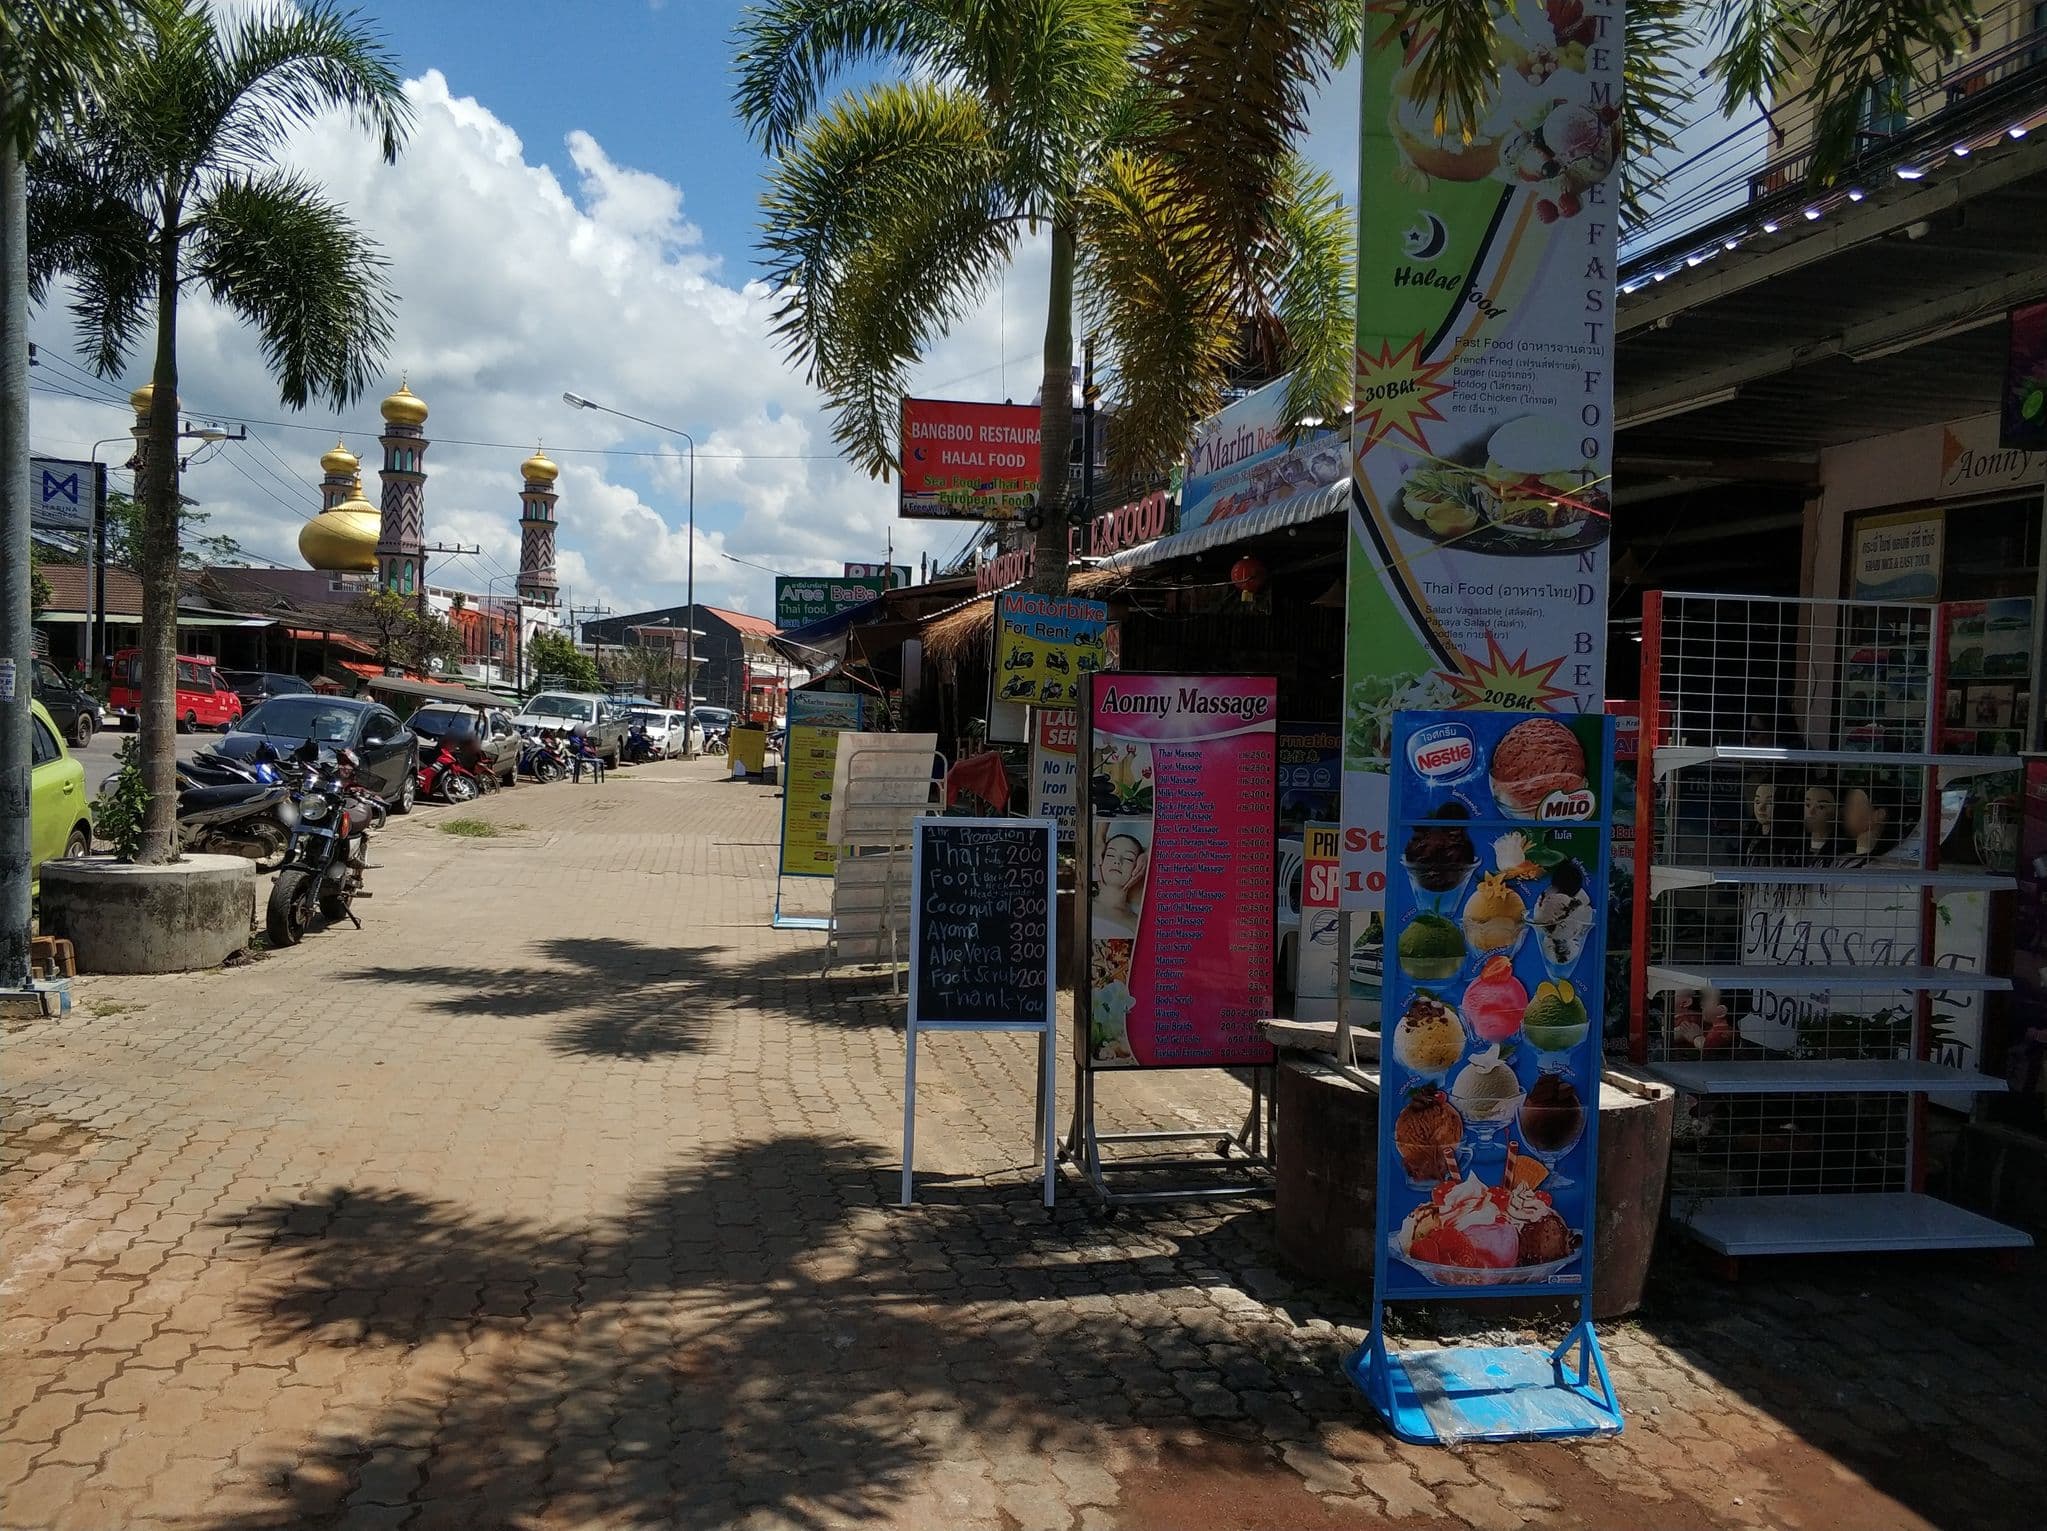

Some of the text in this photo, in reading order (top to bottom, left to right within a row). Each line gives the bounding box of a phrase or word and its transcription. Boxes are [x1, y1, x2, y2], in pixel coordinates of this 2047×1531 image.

[1394, 266, 1461, 291] Halal
[1584, 223, 1608, 344] FAST
[1455, 337, 1480, 348] Fast
[1485, 338, 1513, 350] Food
[1454, 355, 1512, 367] French Fried
[1453, 367, 1485, 378] Burger
[1453, 380, 1487, 391] Hotdog
[1453, 392, 1476, 401] Fried
[1480, 393, 1517, 403] Chicken
[912, 422, 1041, 445] BANGBOO RESTAURA
[1205, 425, 1254, 475] Marlin
[942, 450, 1026, 468] HALAL FOOD
[1949, 449, 2032, 486] Aonny
[1002, 493, 1031, 506] Food
[1090, 490, 1166, 557] EAFOOD
[780, 585, 877, 602] Aree BaBa
[1423, 582, 1453, 594] Thai
[1458, 583, 1493, 596] Food
[779, 604, 800, 614] Thai
[1004, 594, 1105, 621] Motorbike
[1425, 605, 1453, 615] Salad
[1004, 620, 1073, 639] For Rent
[1463, 617, 1491, 627] Salad
[1572, 632, 1596, 713] BEV
[1102, 686, 1268, 720] Aonny Massage
[1046, 711, 1077, 726] LAU
[1048, 729, 1077, 745] SER
[1175, 749, 1202, 759] Massage
[1043, 761, 1077, 775] No Ir
[1175, 763, 1202, 772] Massage
[1042, 781, 1067, 794] Iron
[1041, 803, 1076, 820] Expre
[1545, 801, 1590, 818] MILO
[928, 840, 980, 868] Thai
[1006, 845, 1042, 865] 200
[930, 867, 980, 888] Foot
[1006, 868, 1045, 888] 250
[1310, 865, 1339, 901] SP
[926, 893, 993, 918] Coconut
[1013, 896, 1046, 918] 300
[1010, 922, 1046, 941] 300
[930, 942, 1045, 965] Aloe Vera 300
[931, 966, 970, 988] Foot
[1018, 968, 1046, 988] 200
[939, 988, 1044, 1015] Thank You
